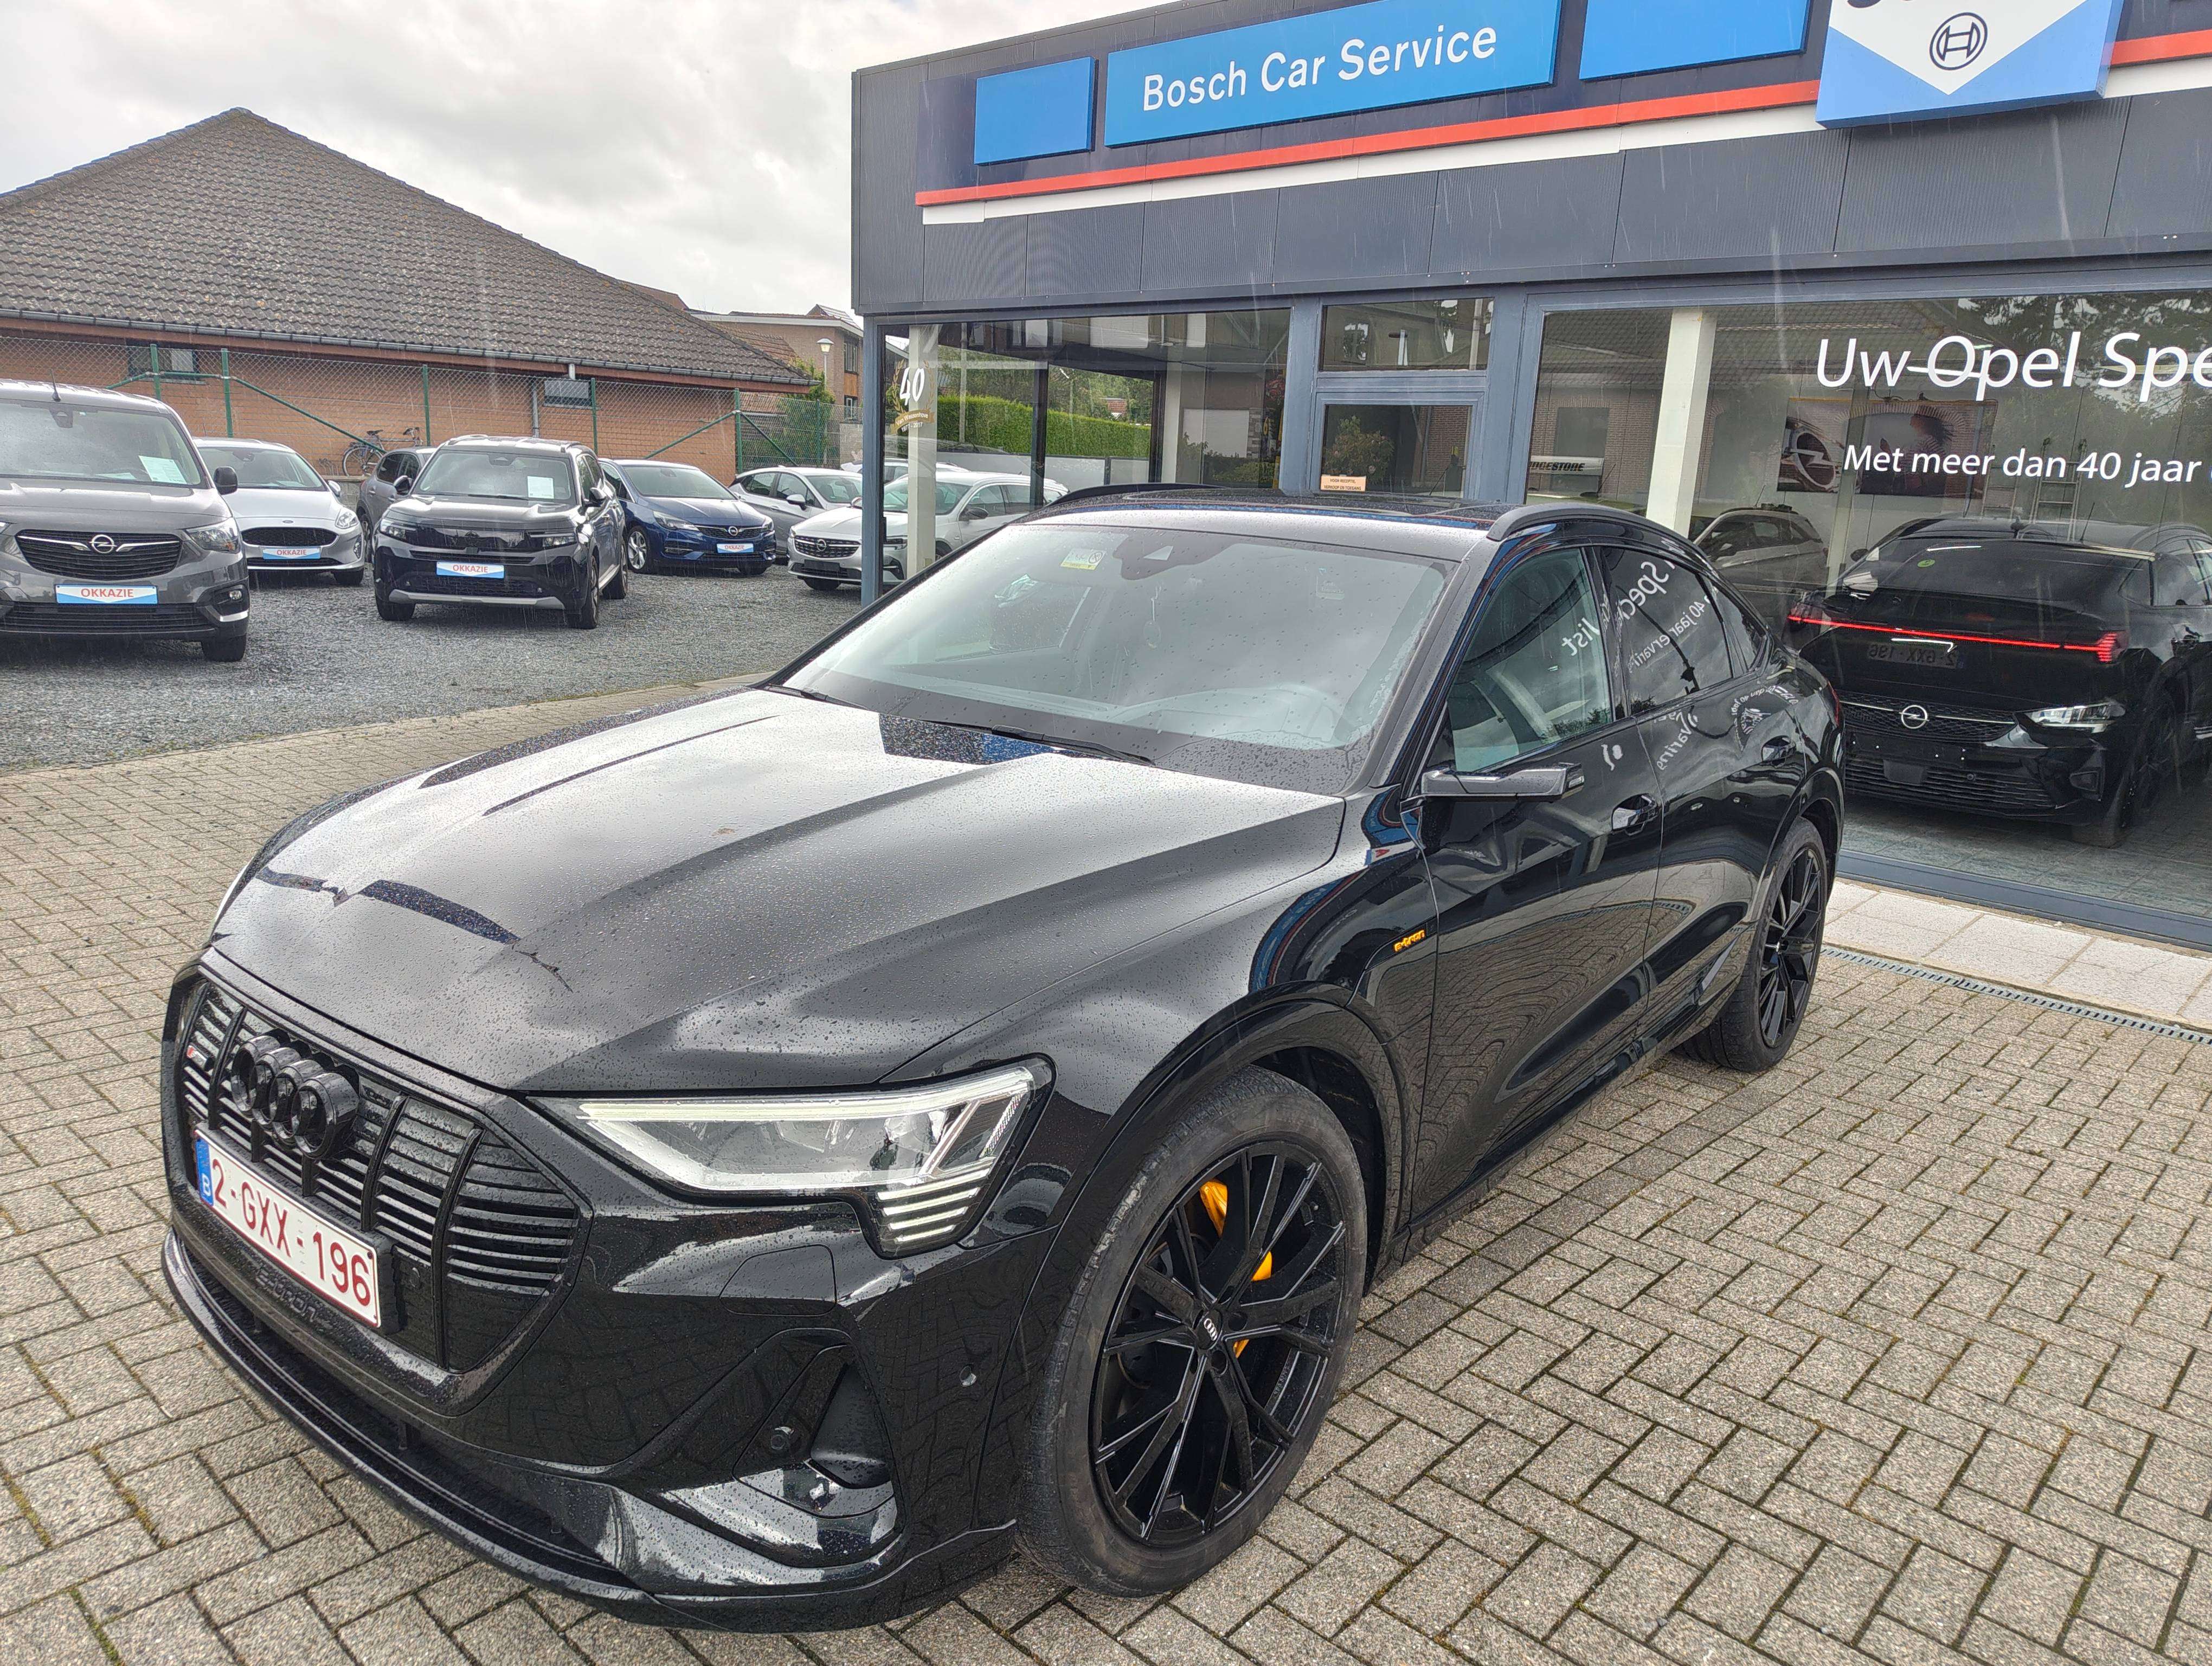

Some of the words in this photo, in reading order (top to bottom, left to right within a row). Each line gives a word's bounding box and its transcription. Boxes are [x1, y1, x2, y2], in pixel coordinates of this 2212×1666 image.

[1142, 60, 1246, 111] Bosch
[1261, 52, 1326, 92] Car
[1338, 24, 1497, 81] Service
[1817, 338, 1911, 387] Uw
[1927, 331, 2081, 401] Opel
[899, 367, 925, 406] 40
[1843, 444, 1904, 473] Met
[1911, 451, 1996, 476] meer
[2002, 448, 2066, 478] dan
[2076, 451, 2121, 480] 40
[2124, 451, 2202, 488] jaar
[453, 565, 488, 573] OKKAZIE
[80, 588, 134, 598] OKKAZIE
[1394, 930, 1425, 952] e-tron
[202, 1173, 211, 1197] B
